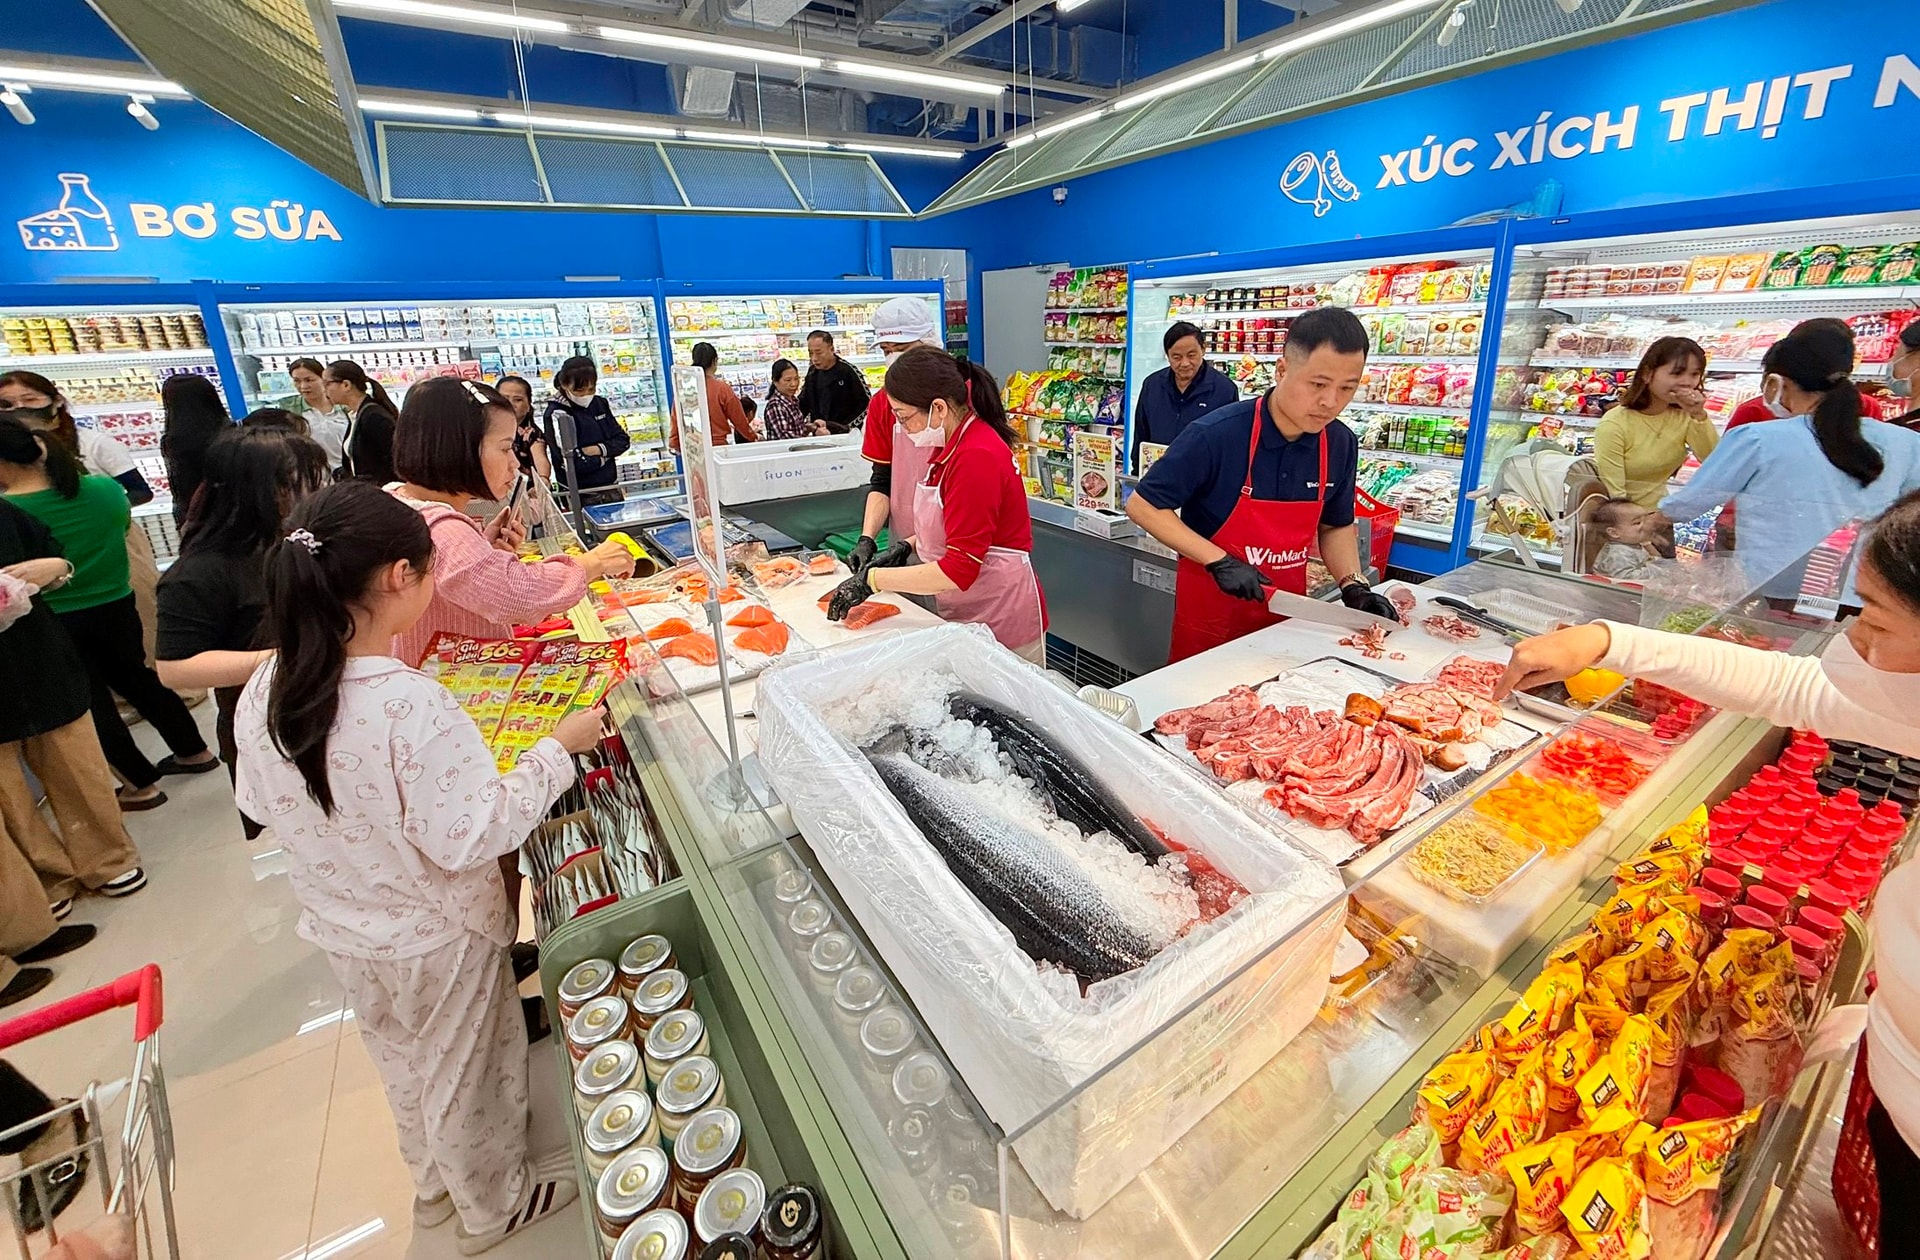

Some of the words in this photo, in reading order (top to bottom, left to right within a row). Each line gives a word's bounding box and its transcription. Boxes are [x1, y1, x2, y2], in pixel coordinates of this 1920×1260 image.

[1376, 134, 1478, 190] XÚC
[1489, 105, 1640, 171] XÍCH
[1659, 64, 1854, 142] THỊT
[129, 202, 218, 240] BƠ
[231, 199, 343, 242] SỮA
[1245, 546, 1307, 565] WinMart
[1586, 1195, 1607, 1228] CHIN-SU
